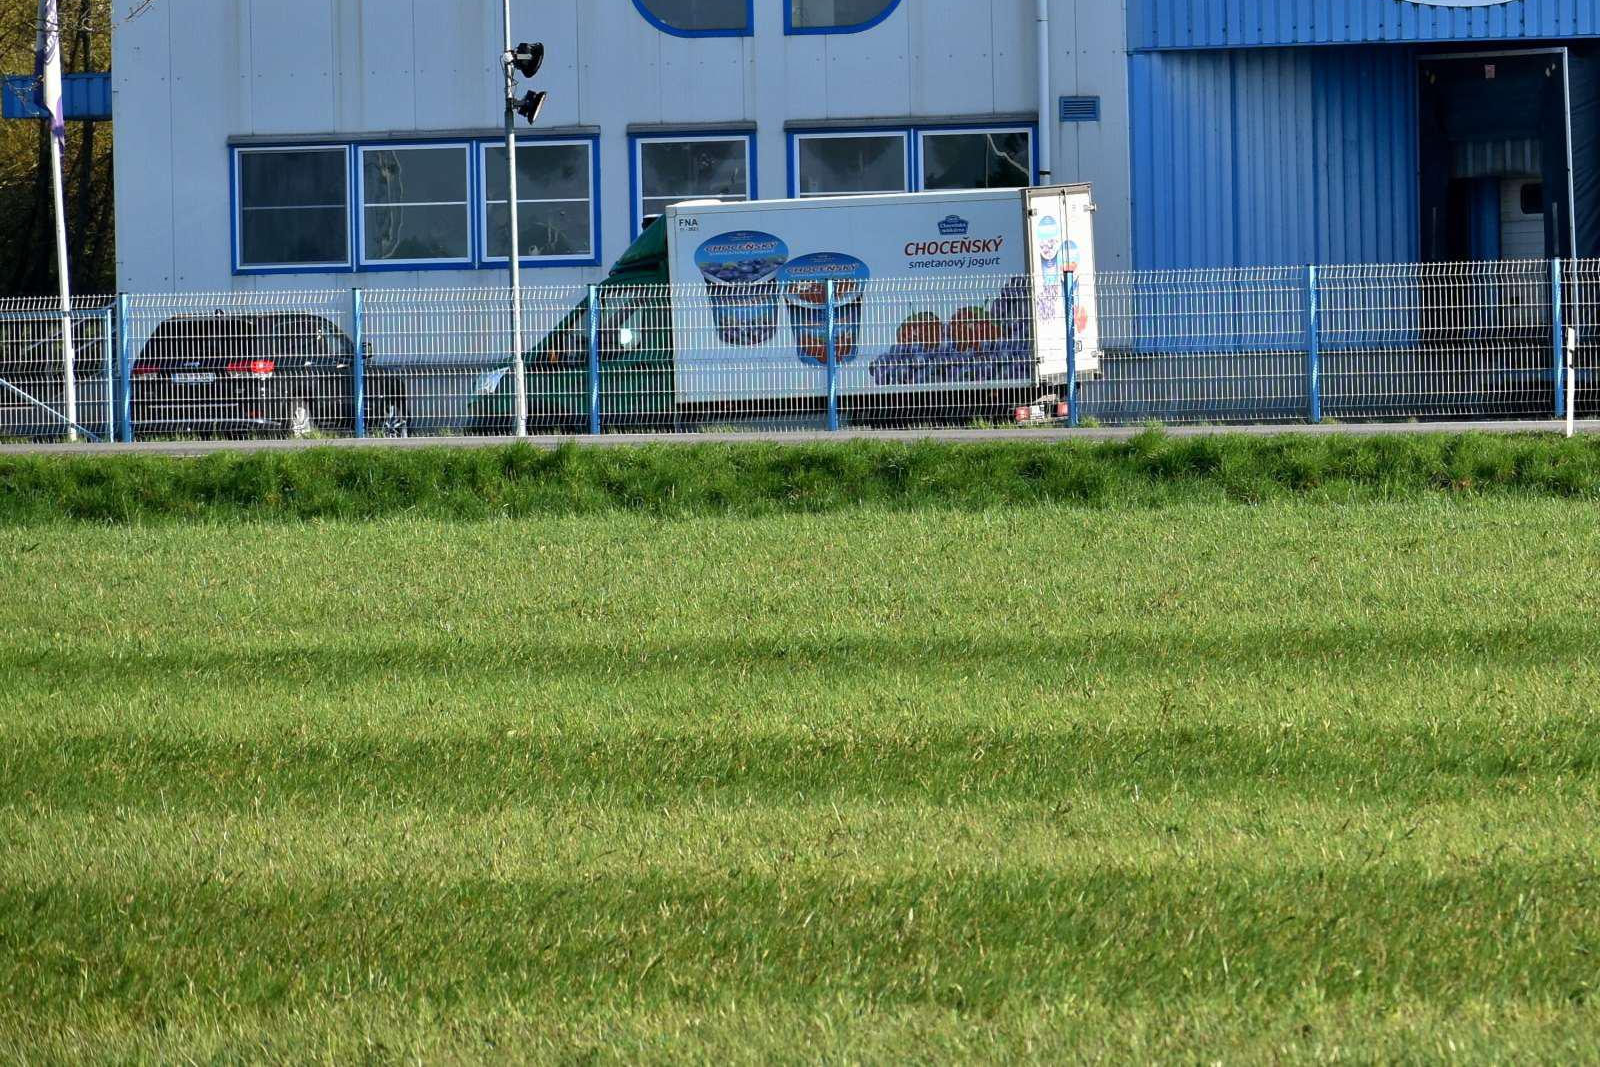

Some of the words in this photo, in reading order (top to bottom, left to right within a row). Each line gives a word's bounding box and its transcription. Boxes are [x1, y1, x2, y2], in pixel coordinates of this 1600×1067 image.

[678, 218, 698, 227] FNA
[904, 235, 1004, 256] CHOCEŇSKÝ
[908, 256, 966, 269] smetanový
[967, 256, 1001, 268] jogurt
